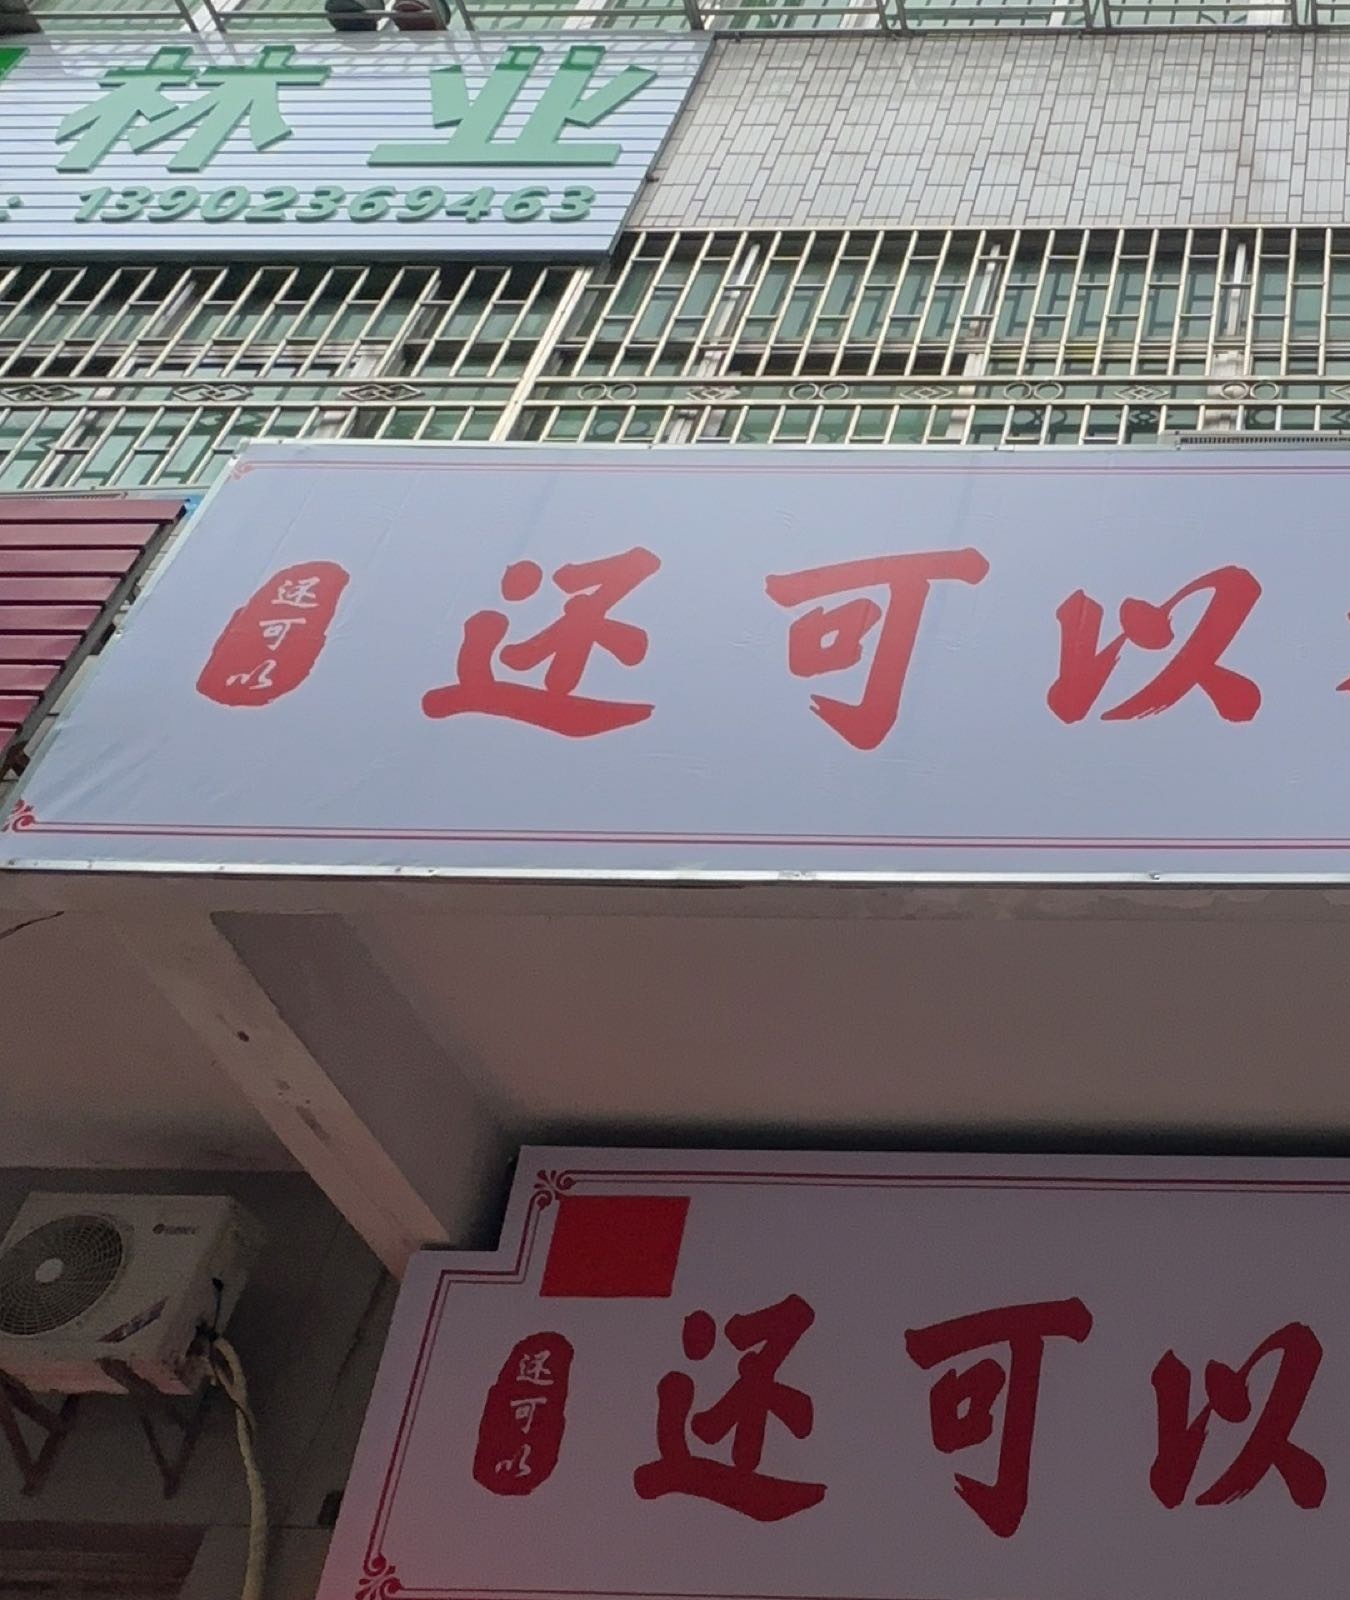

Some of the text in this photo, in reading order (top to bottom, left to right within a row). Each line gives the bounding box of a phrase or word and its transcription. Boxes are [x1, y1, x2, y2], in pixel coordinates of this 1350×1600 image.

[54, 45, 659, 173] 林业
[74, 184, 598, 223] 13902369463
[225, 576, 321, 690] 还可以
[494, 1350, 555, 1478] 还可以
